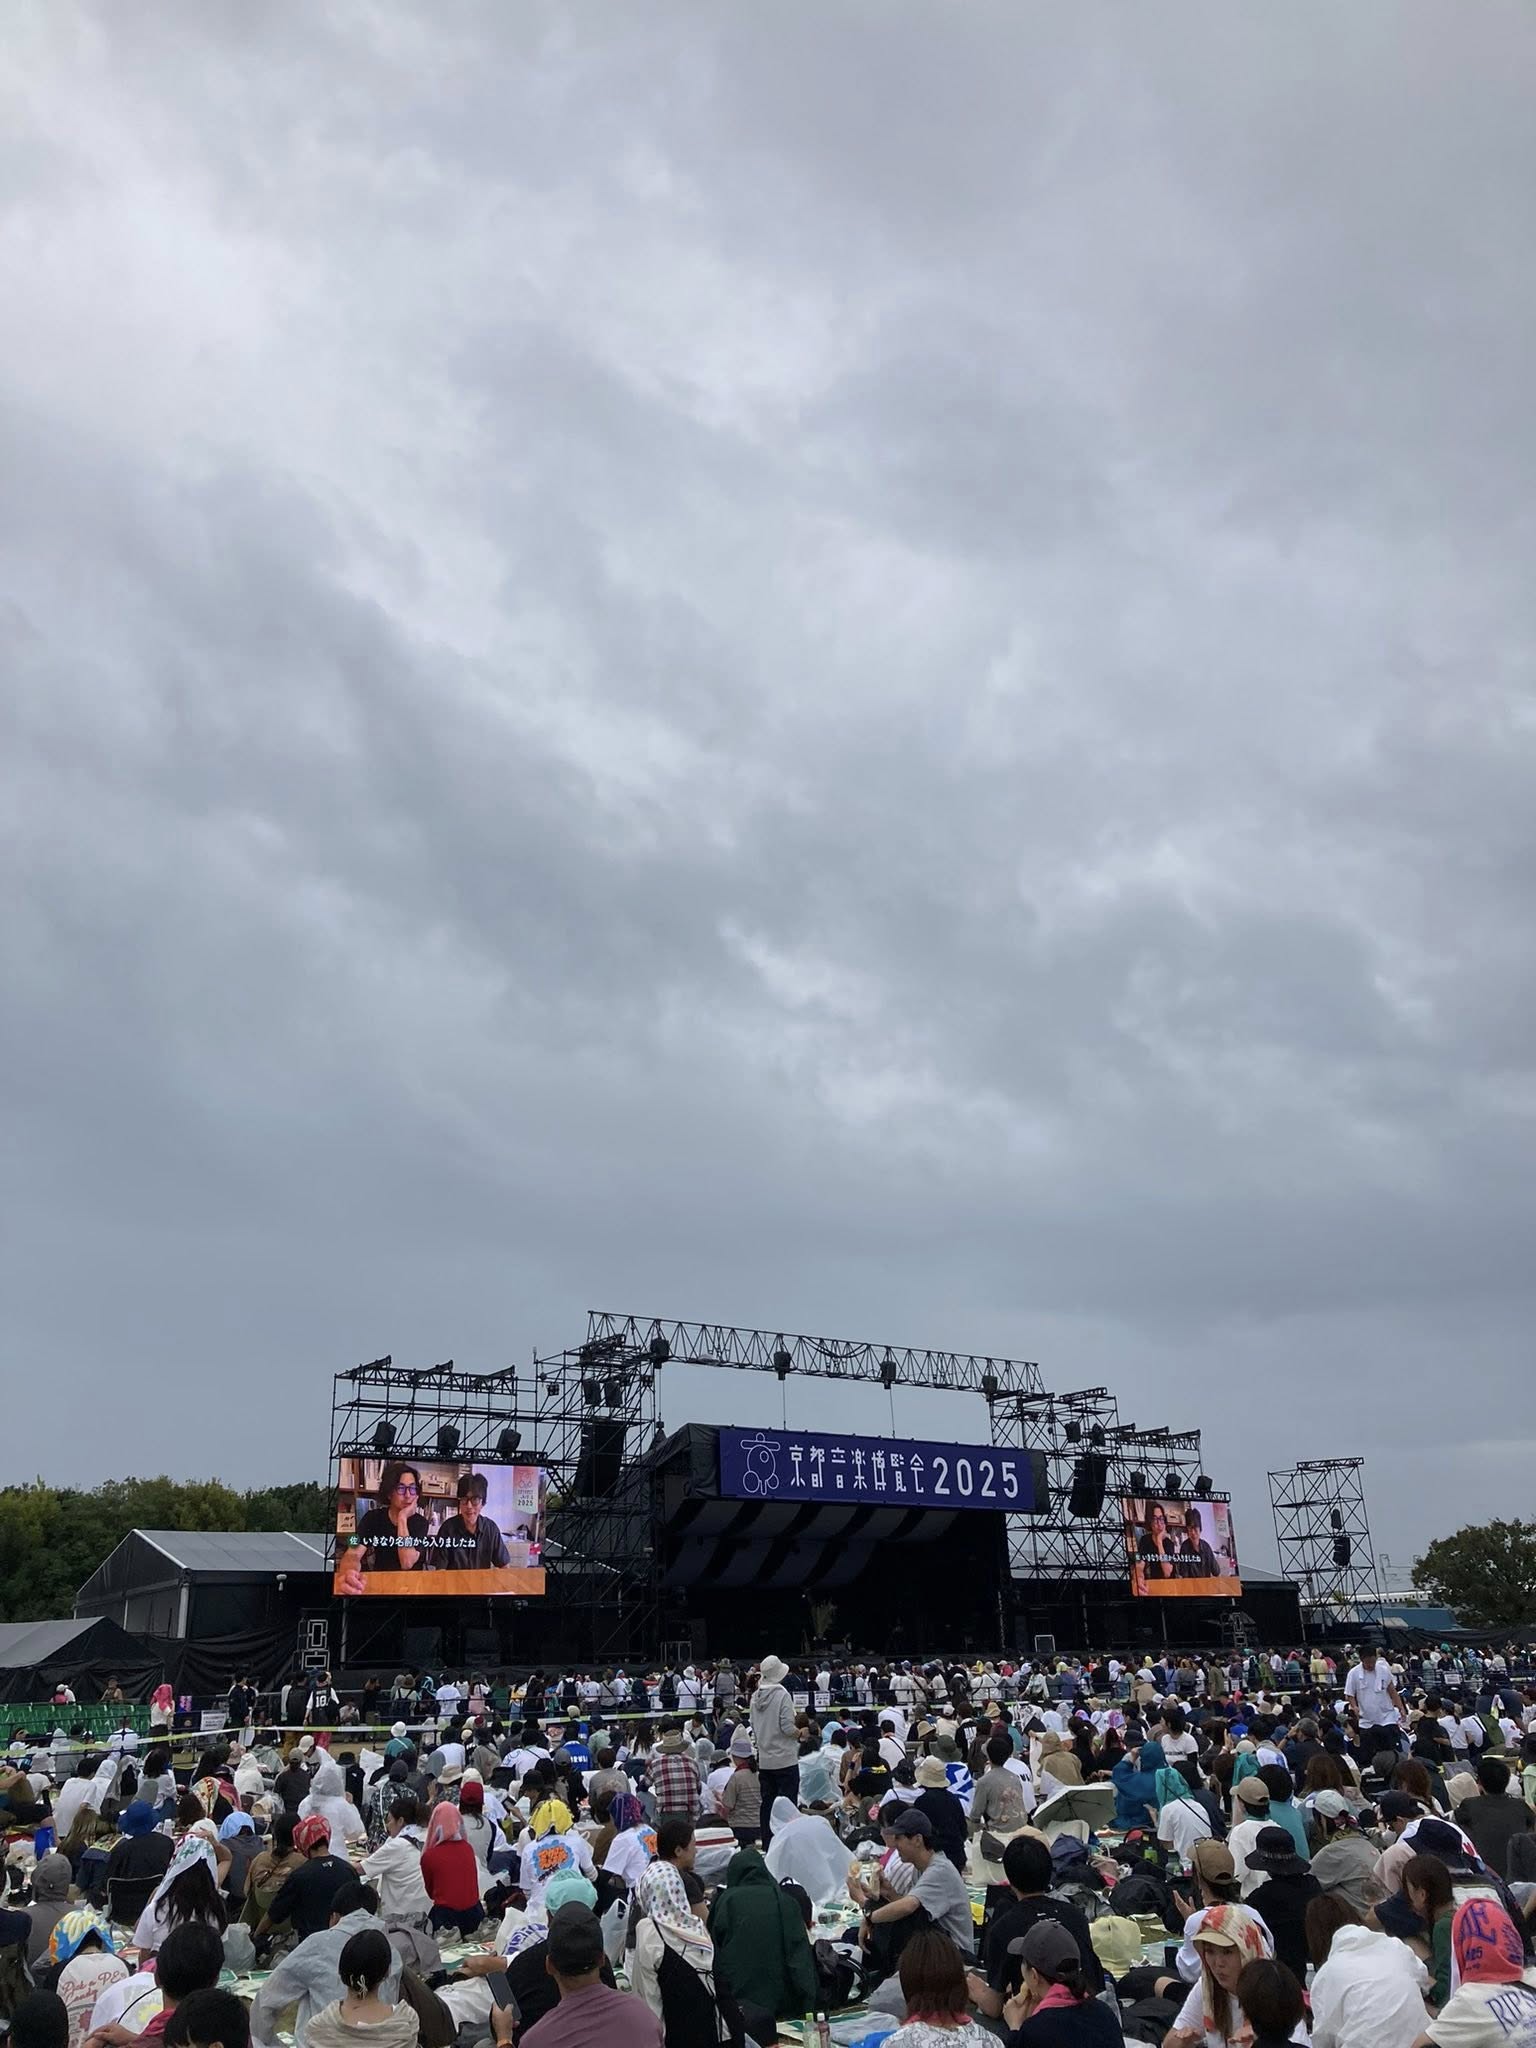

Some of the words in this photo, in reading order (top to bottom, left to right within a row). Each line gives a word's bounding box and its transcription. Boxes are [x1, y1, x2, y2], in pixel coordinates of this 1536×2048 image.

[363, 1535, 476, 1548] いきなり名前から入りましたね
